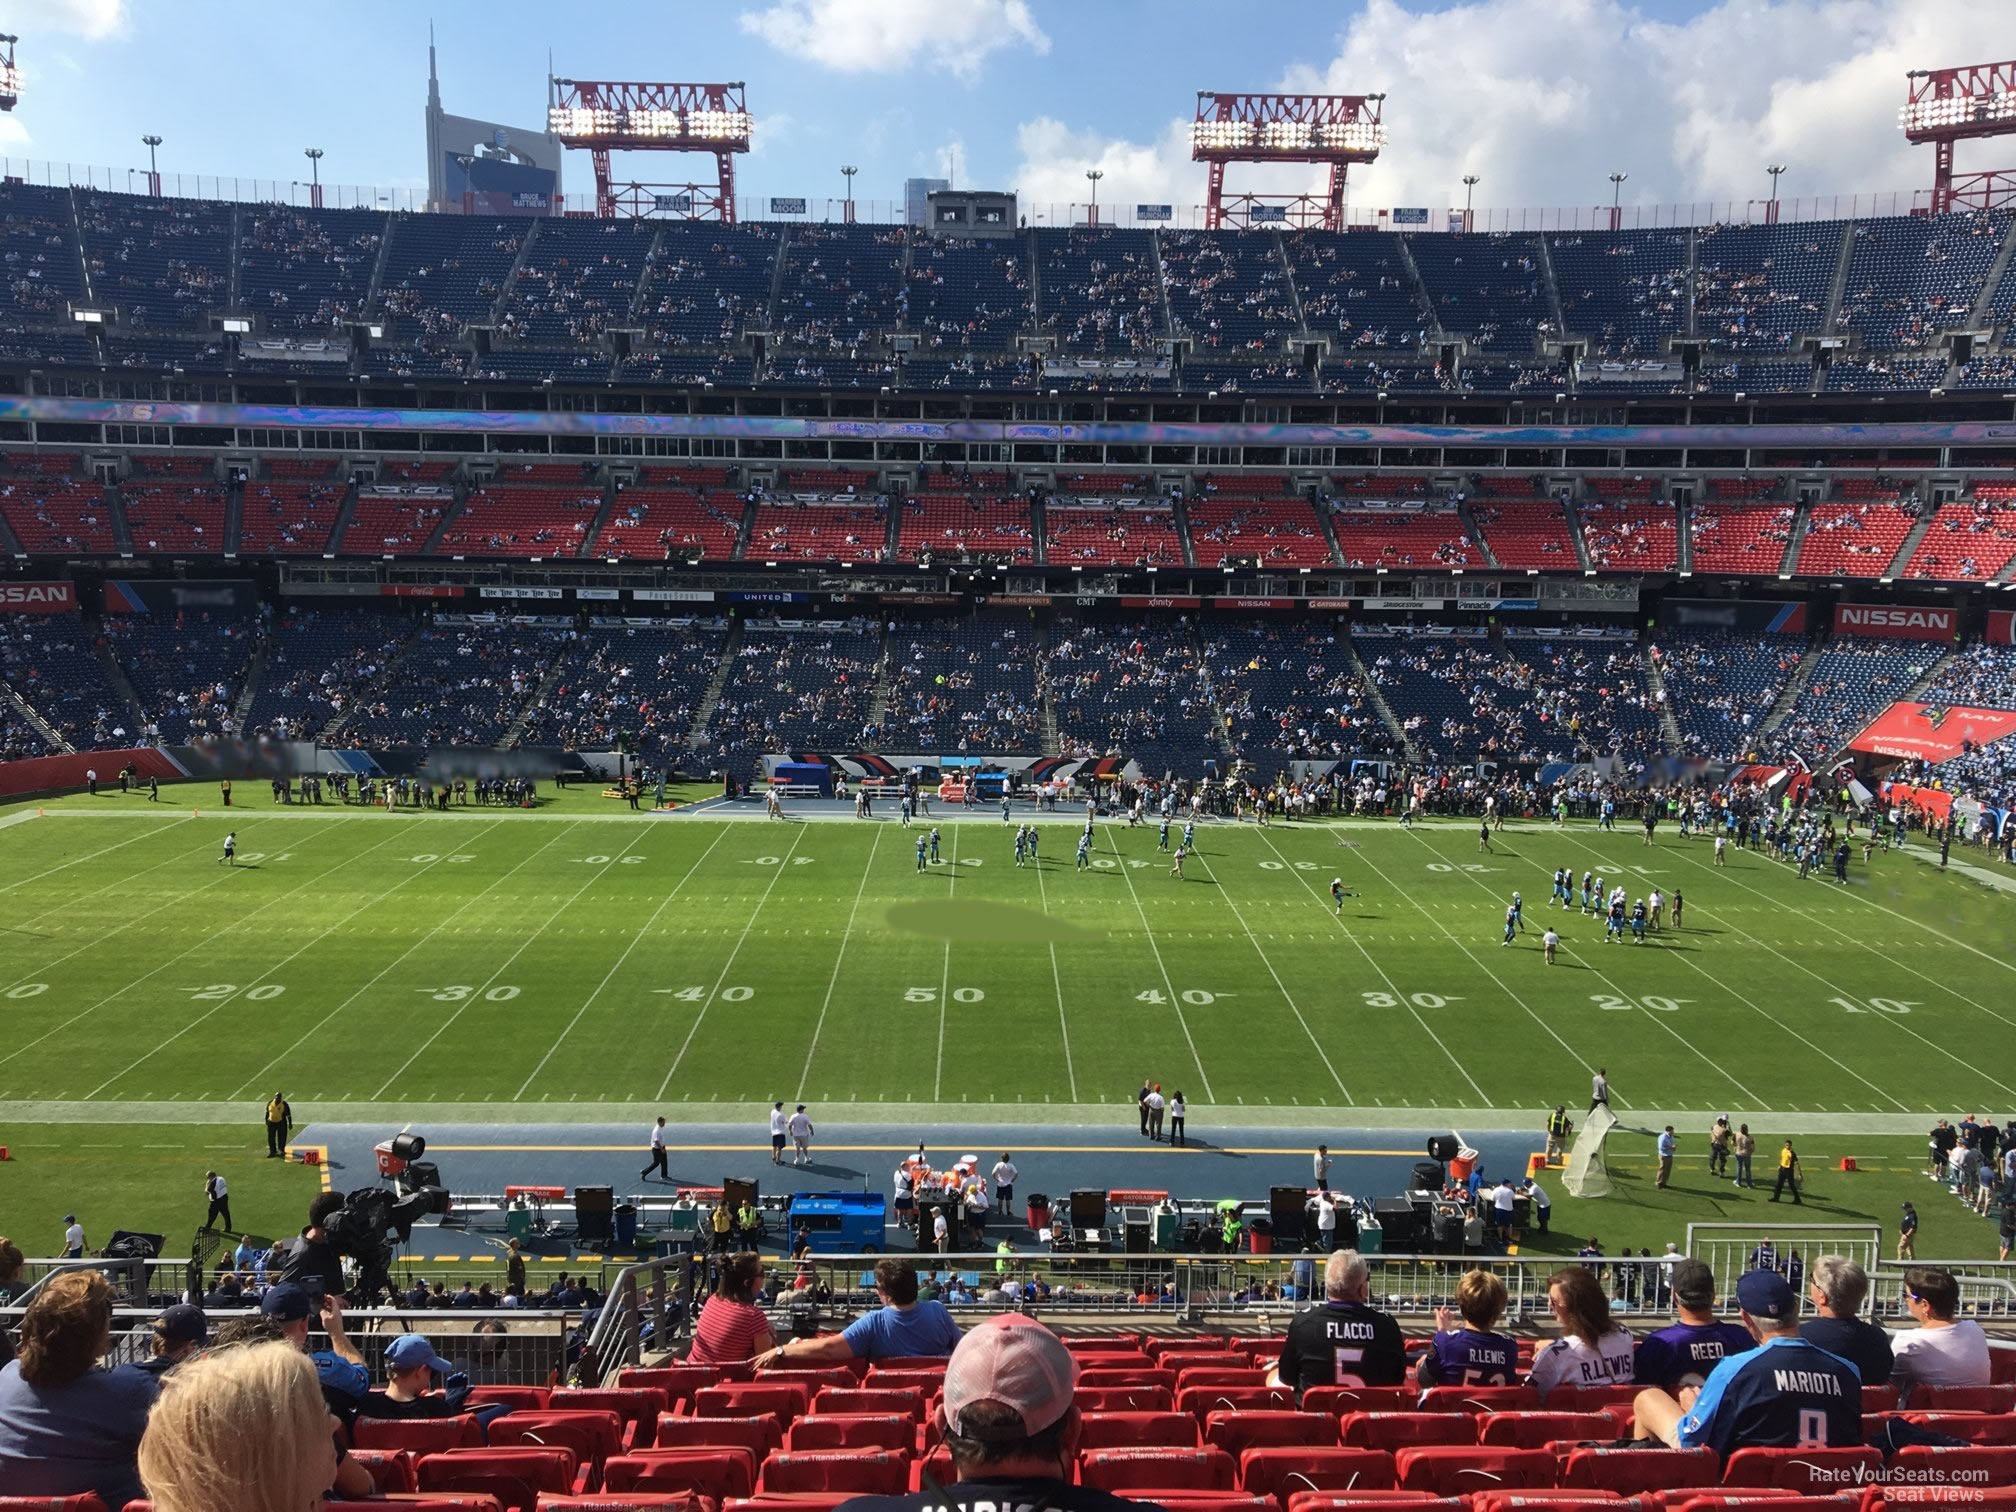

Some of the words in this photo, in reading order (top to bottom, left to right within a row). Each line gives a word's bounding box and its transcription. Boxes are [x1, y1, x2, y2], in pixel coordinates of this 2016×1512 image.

[1138, 211, 1171, 219] MUNCHAK
[1253, 213, 1284, 221] NORTON
[0, 586, 68, 602] SAN
[1076, 598, 1096, 606] CMT
[1148, 598, 1173, 607] xfinity
[1238, 600, 1271, 608] NISSAN
[1458, 601, 1492, 609] Pinnacle
[1841, 608, 1949, 629] NISSAN
[1873, 745, 1923, 760] NISSAN
[306, 1152, 318, 1163] 30
[380, 1155, 389, 1167] G
[1326, 1322, 1375, 1340] FLACCO
[1469, 1348, 1506, 1365] R.LEWIS
[1690, 1342, 1724, 1361] REED
[1335, 1347, 1366, 1388] 5
[1774, 1370, 1842, 1397] MARIOTA
